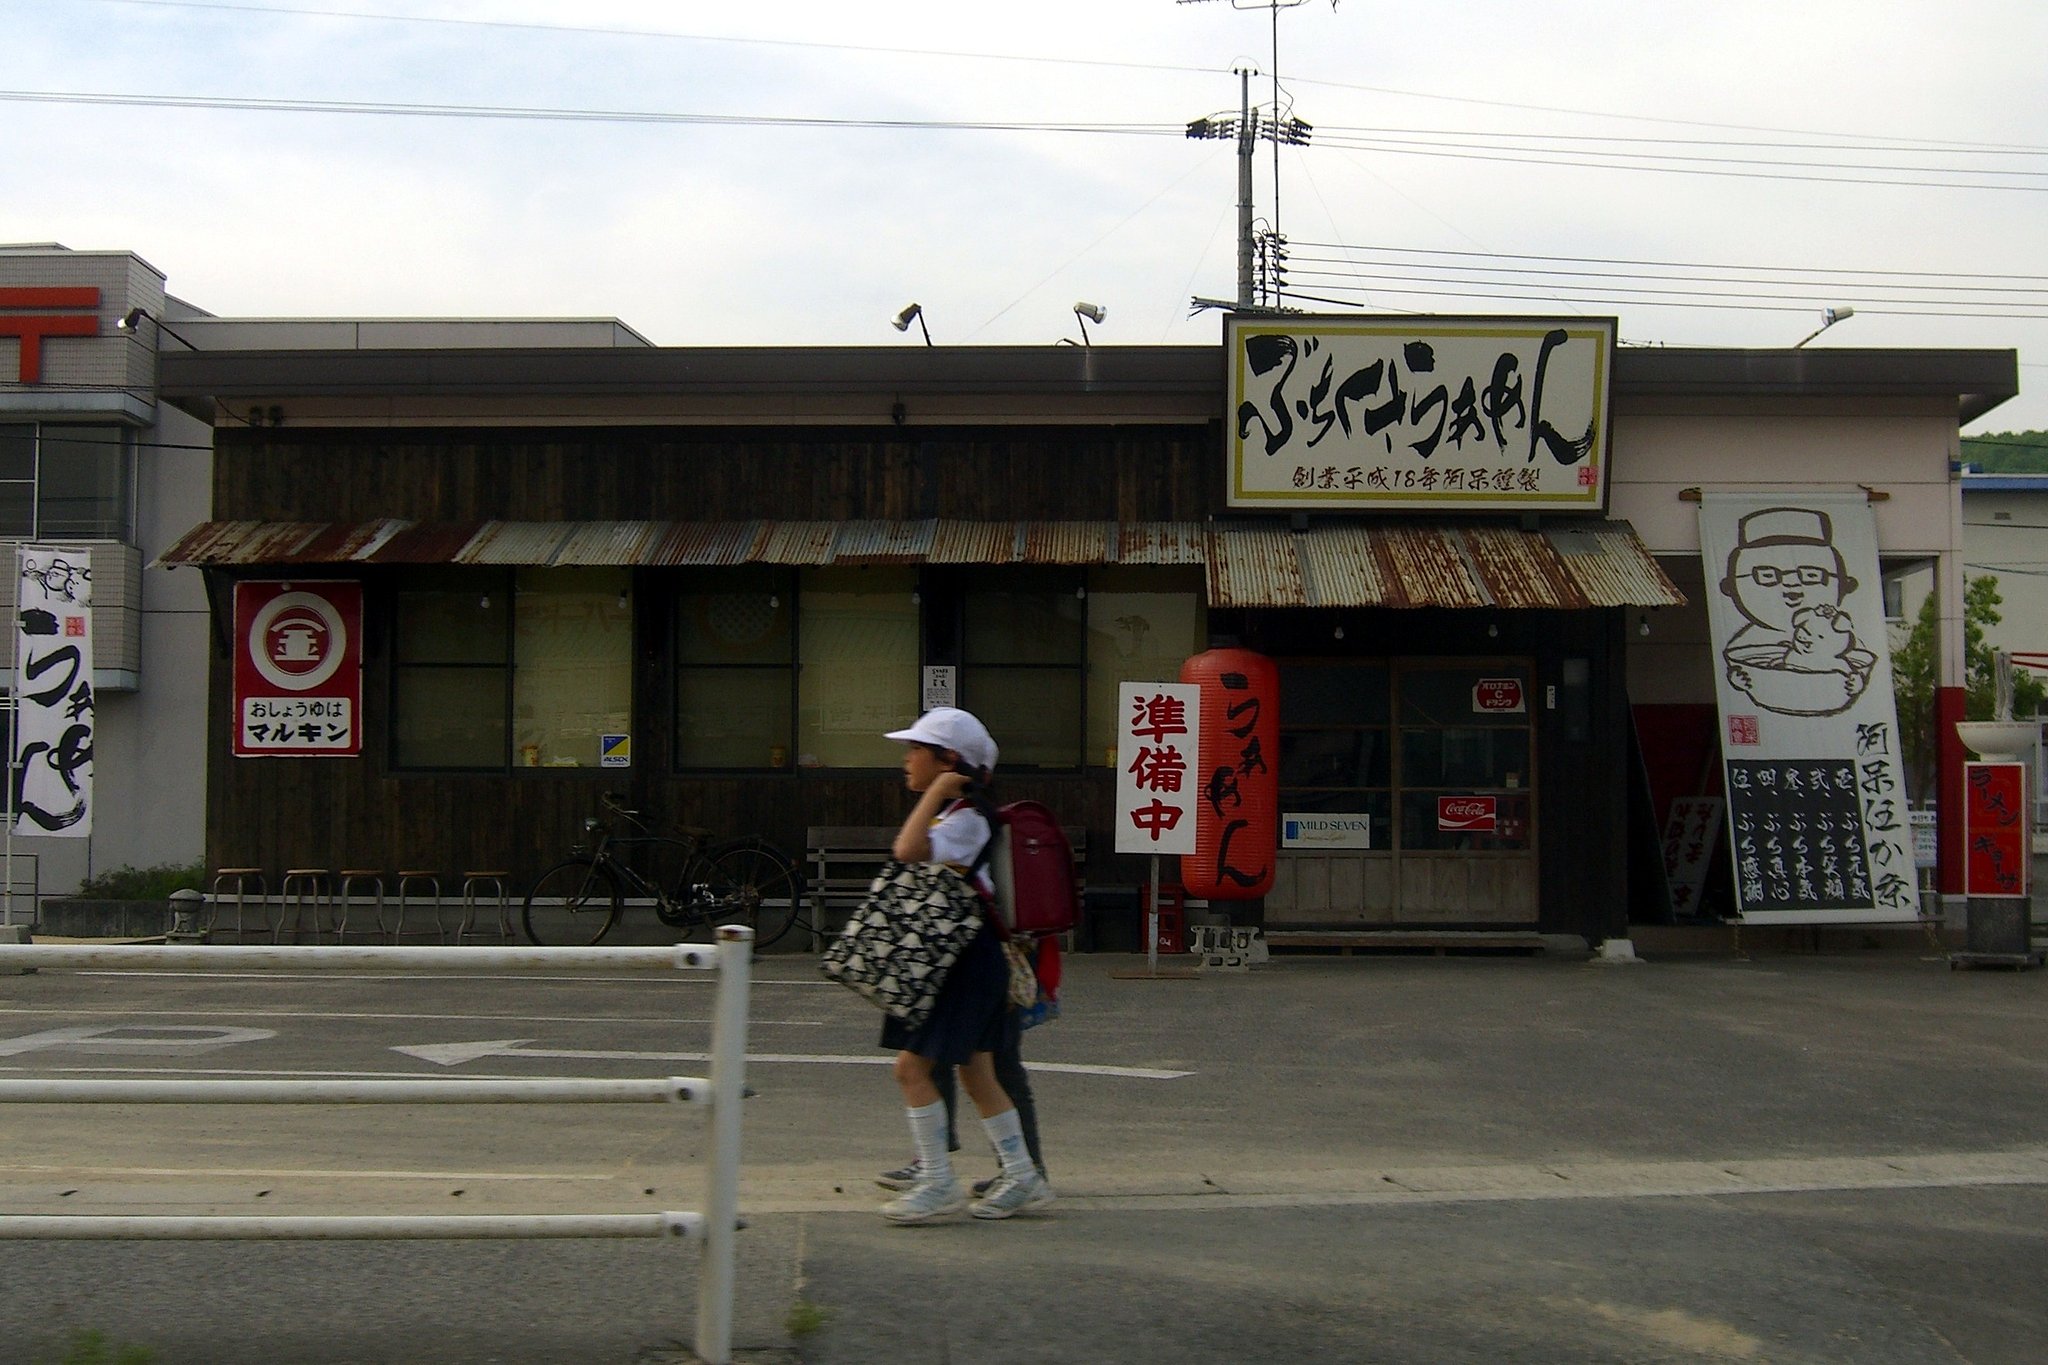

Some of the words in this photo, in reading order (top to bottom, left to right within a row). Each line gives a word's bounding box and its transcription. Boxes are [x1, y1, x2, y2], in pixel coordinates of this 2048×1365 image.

[250, 701, 344, 718] おしょうゆは
[248, 723, 349, 743] マルキン
[1128, 694, 1188, 841] 準備中
[1204, 672, 1268, 887] らぁめん
[1971, 768, 2021, 826] ラーメン
[1299, 821, 1328, 831] MILD
[1329, 820, 1367, 831] SEVEN
